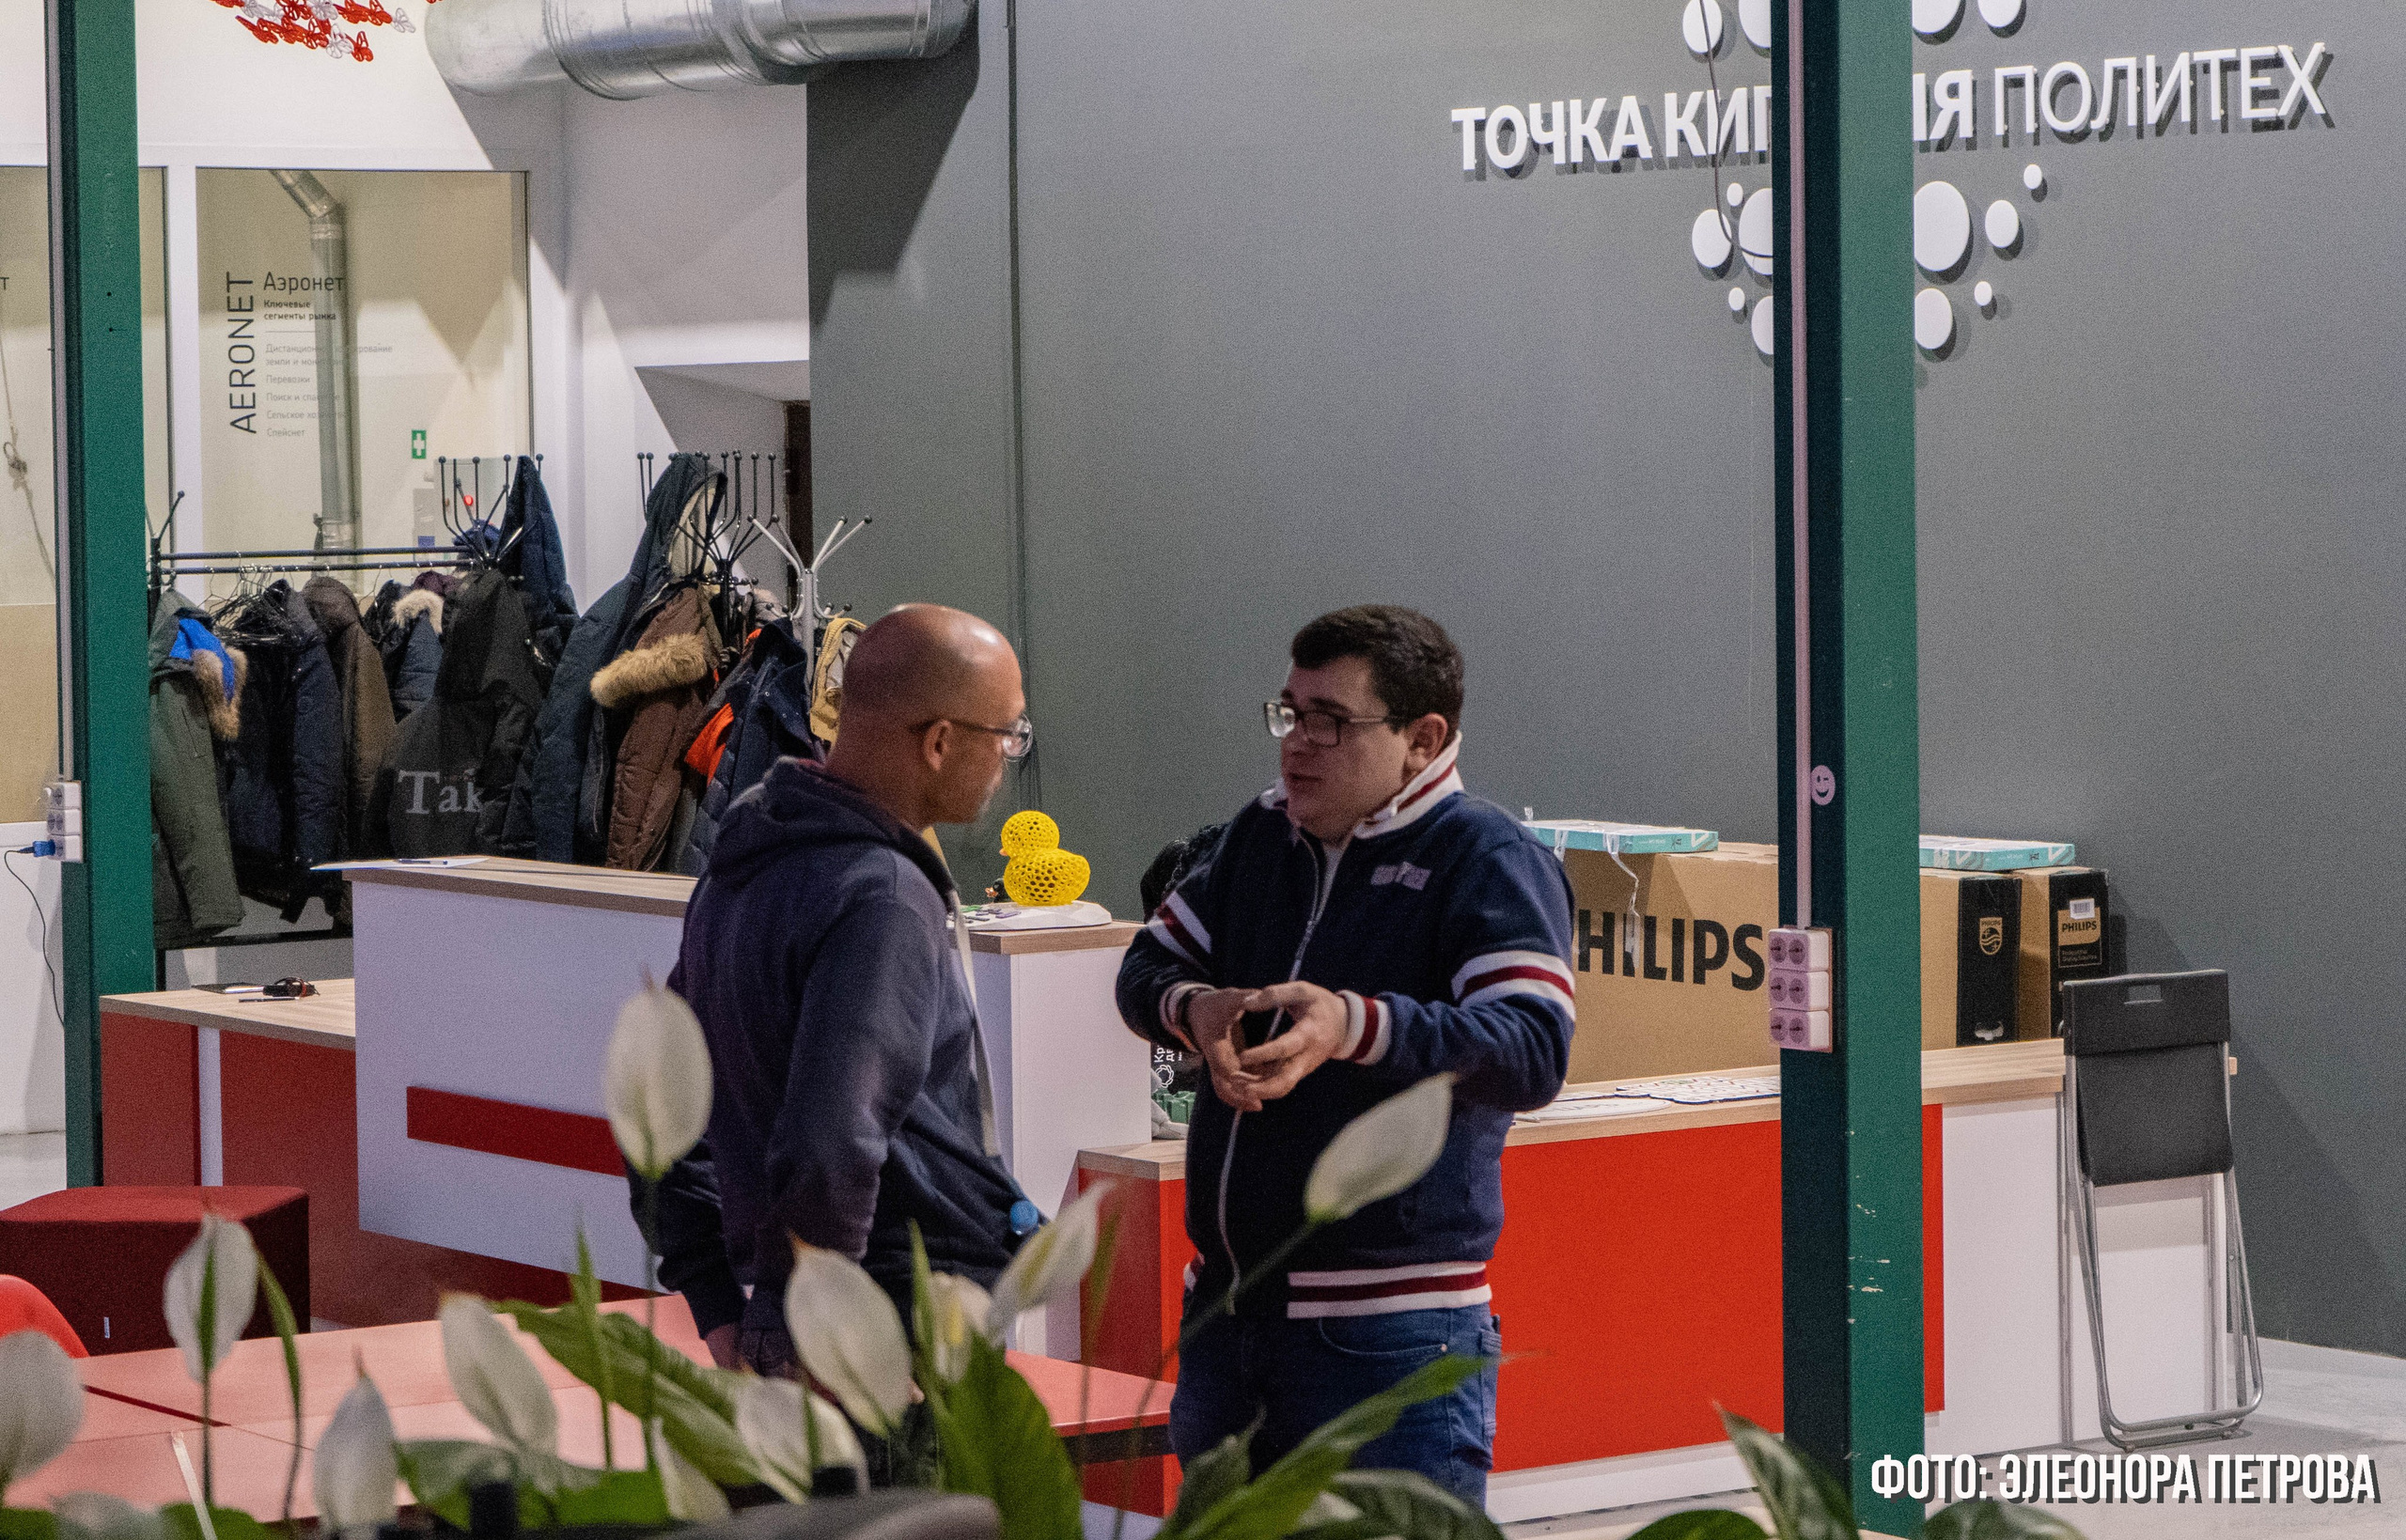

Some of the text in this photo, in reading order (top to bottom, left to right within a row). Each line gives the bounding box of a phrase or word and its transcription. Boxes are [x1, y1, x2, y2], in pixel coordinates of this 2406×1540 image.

[1452, 93, 1652, 170] ТОЧКА
[1994, 42, 2328, 137] ПОЛИТЕХ
[263, 272, 344, 295] Аэронет
[263, 299, 311, 309] Ключевые
[263, 312, 336, 321] сегменты рынка
[227, 272, 257, 434] AERONET
[265, 374, 311, 384] Перевозки
[265, 393, 292, 402] Поиск
[293, 394, 301, 402] и
[266, 411, 305, 420] Сельское
[2061, 921, 2098, 932] PHILIPS
[1577, 908, 1766, 991] HILIPS
